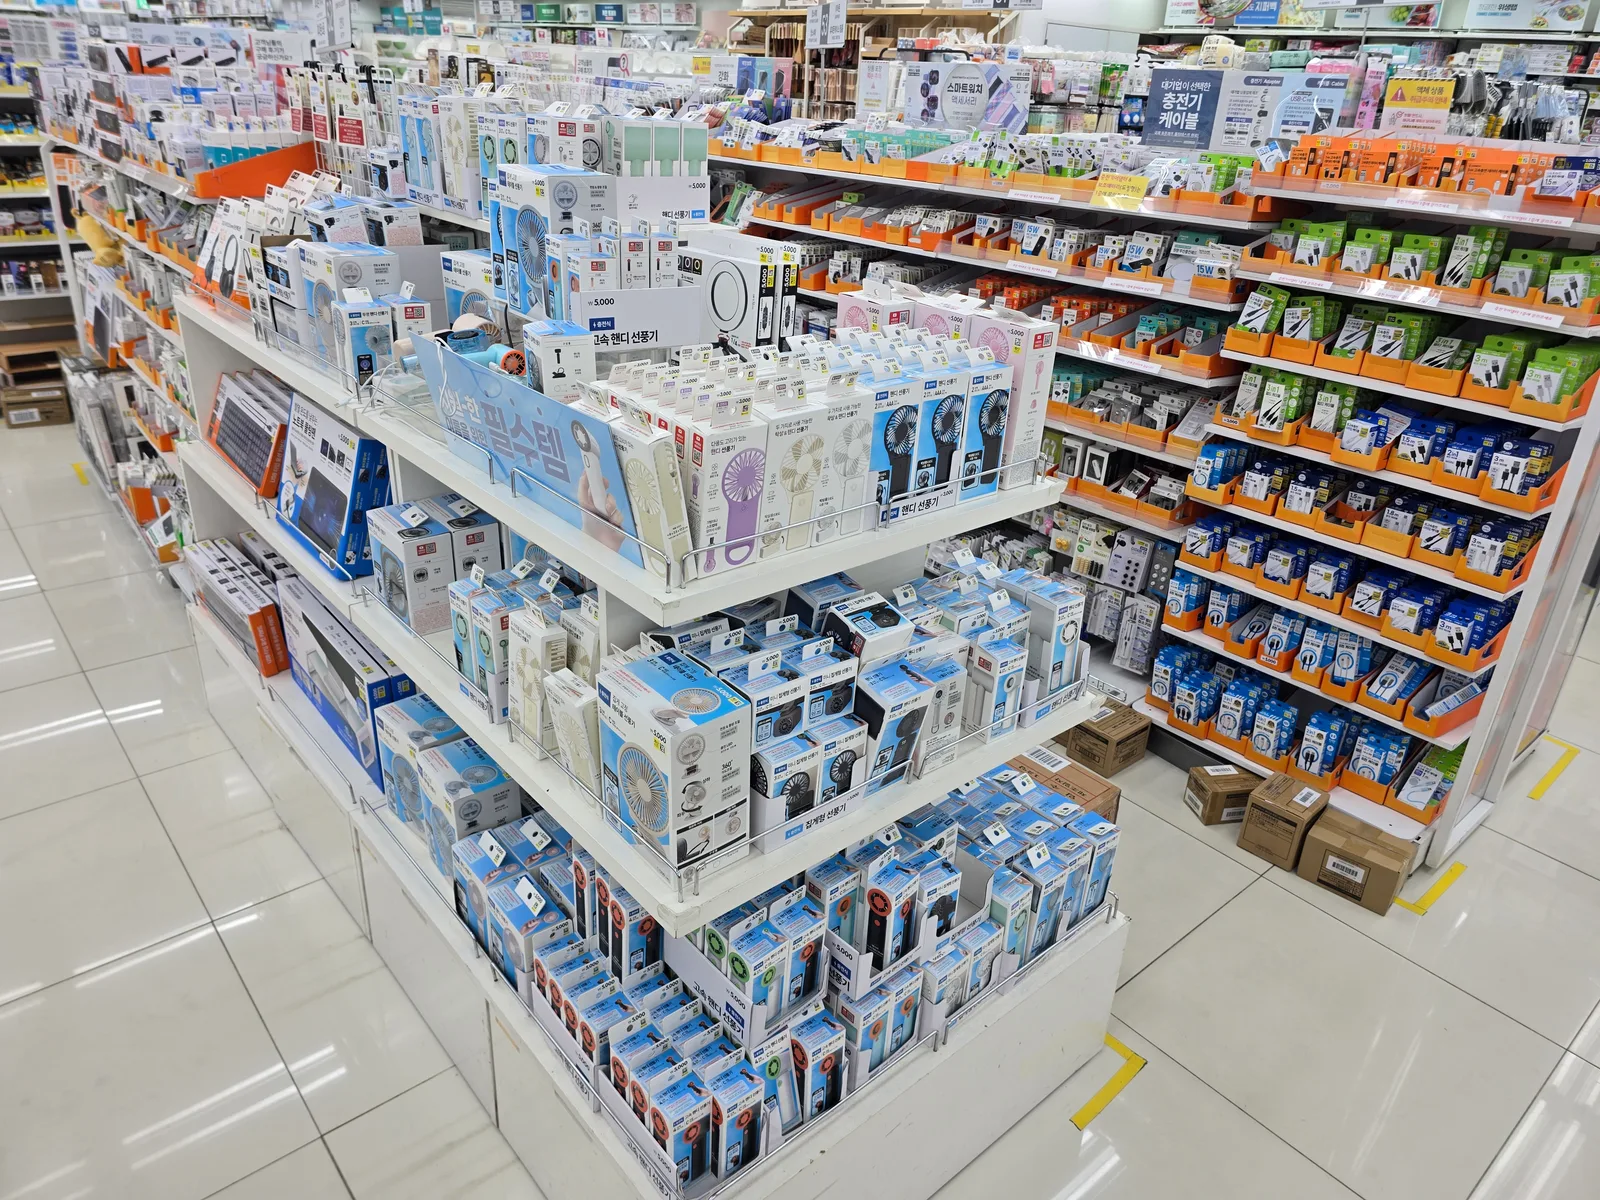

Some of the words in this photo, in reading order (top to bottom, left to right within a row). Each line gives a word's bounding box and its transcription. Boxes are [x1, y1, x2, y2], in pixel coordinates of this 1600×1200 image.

[947, 83, 983, 95] 스마트워치
[1161, 79, 1190, 91] 대기업이
[1190, 81, 1211, 92] 선택한
[951, 96, 977, 107] 액세서리
[1162, 92, 1203, 111] 충전기
[1159, 112, 1199, 130] 케이블
[674, 210, 690, 219] 선풍기
[1027, 225, 1040, 233] 15W
[1127, 244, 1144, 255] 15W
[1197, 264, 1214, 275] 15W
[610, 332, 630, 346] 핸디
[631, 330, 658, 344] 선풍기
[480, 401, 571, 484] 필수템
[901, 503, 915, 516] 핸디
[917, 496, 939, 511] 선풍기
[805, 812, 826, 829] 집게형
[826, 803, 846, 820] 선풍기
[707, 995, 722, 1016] 핸디
[723, 1011, 744, 1039] 선풍기
